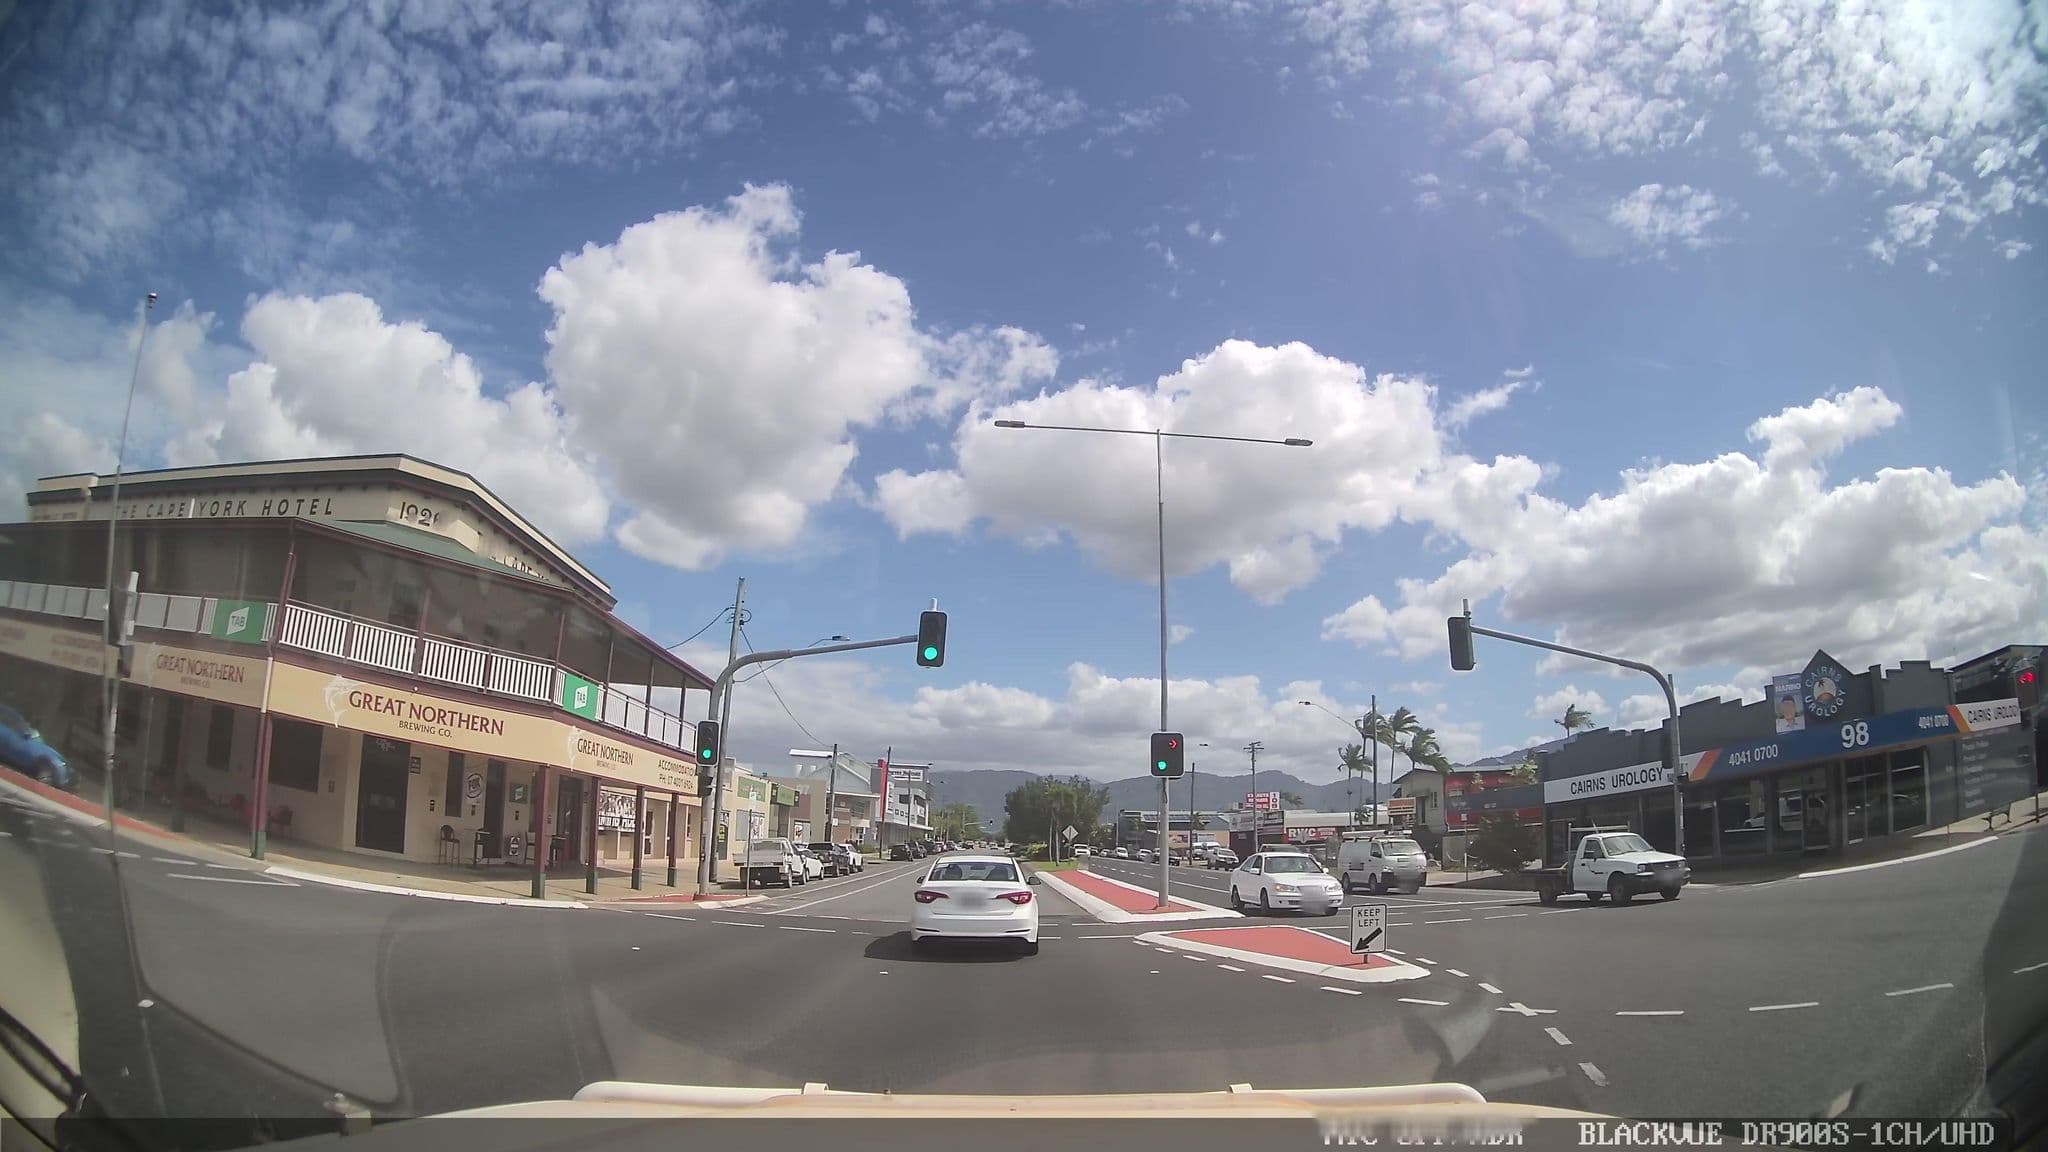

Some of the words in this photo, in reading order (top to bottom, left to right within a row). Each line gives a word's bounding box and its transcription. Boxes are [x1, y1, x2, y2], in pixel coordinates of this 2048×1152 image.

[146, 502, 186, 517] CAPE
[200, 499, 247, 516] YORK
[262, 498, 332, 516] HOTEL
[231, 615, 246, 627] TAB
[157, 654, 186, 672] GREAT
[187, 659, 244, 683] NORTHERN
[348, 690, 405, 716] GREAT
[408, 702, 505, 736] NORTHERN
[1805, 690, 1846, 716] UROLOGY
[1967, 708, 1992, 724] CAIRNS
[398, 721, 435, 735] BREWING
[1841, 721, 1870, 749] 98
[577, 738, 600, 759] GREAT
[600, 744, 634, 766] NORTHERN
[1728, 751, 1751, 766] 4041
[1753, 744, 1778, 762] 0700
[1570, 777, 1606, 795] CAIRNS
[1611, 766, 1664, 788] UROLOGY
[1357, 908, 1381, 918] KEEP
[1358, 919, 1380, 928] LEFT
